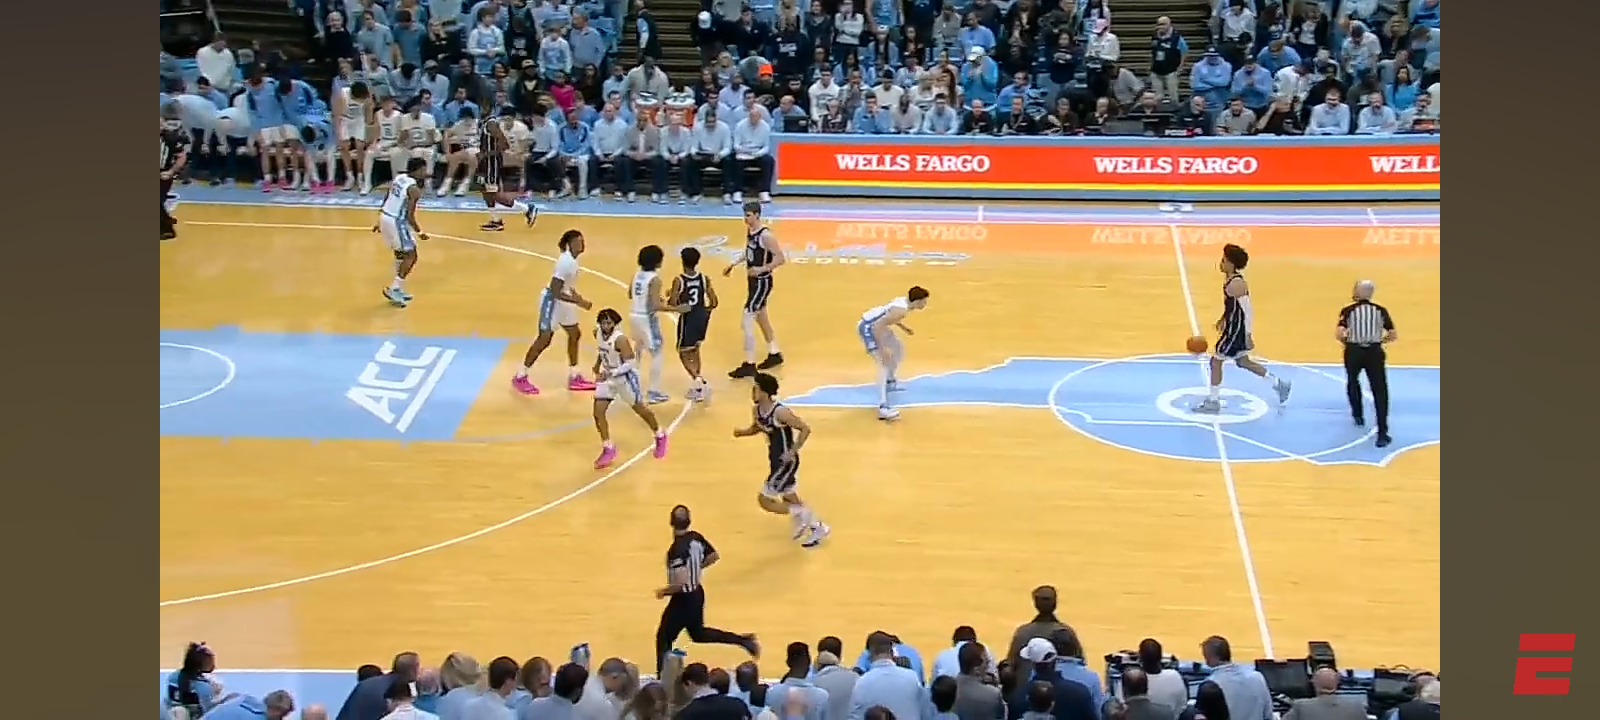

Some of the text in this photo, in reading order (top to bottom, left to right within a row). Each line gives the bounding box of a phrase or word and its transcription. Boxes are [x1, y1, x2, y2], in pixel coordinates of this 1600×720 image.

[835, 154, 990, 172] WELLS FARGO
[1093, 156, 1258, 174] WELLS FARGO
[1368, 155, 1440, 173] WELL
[688, 287, 699, 306] 3
[345, 341, 441, 425] ACC
